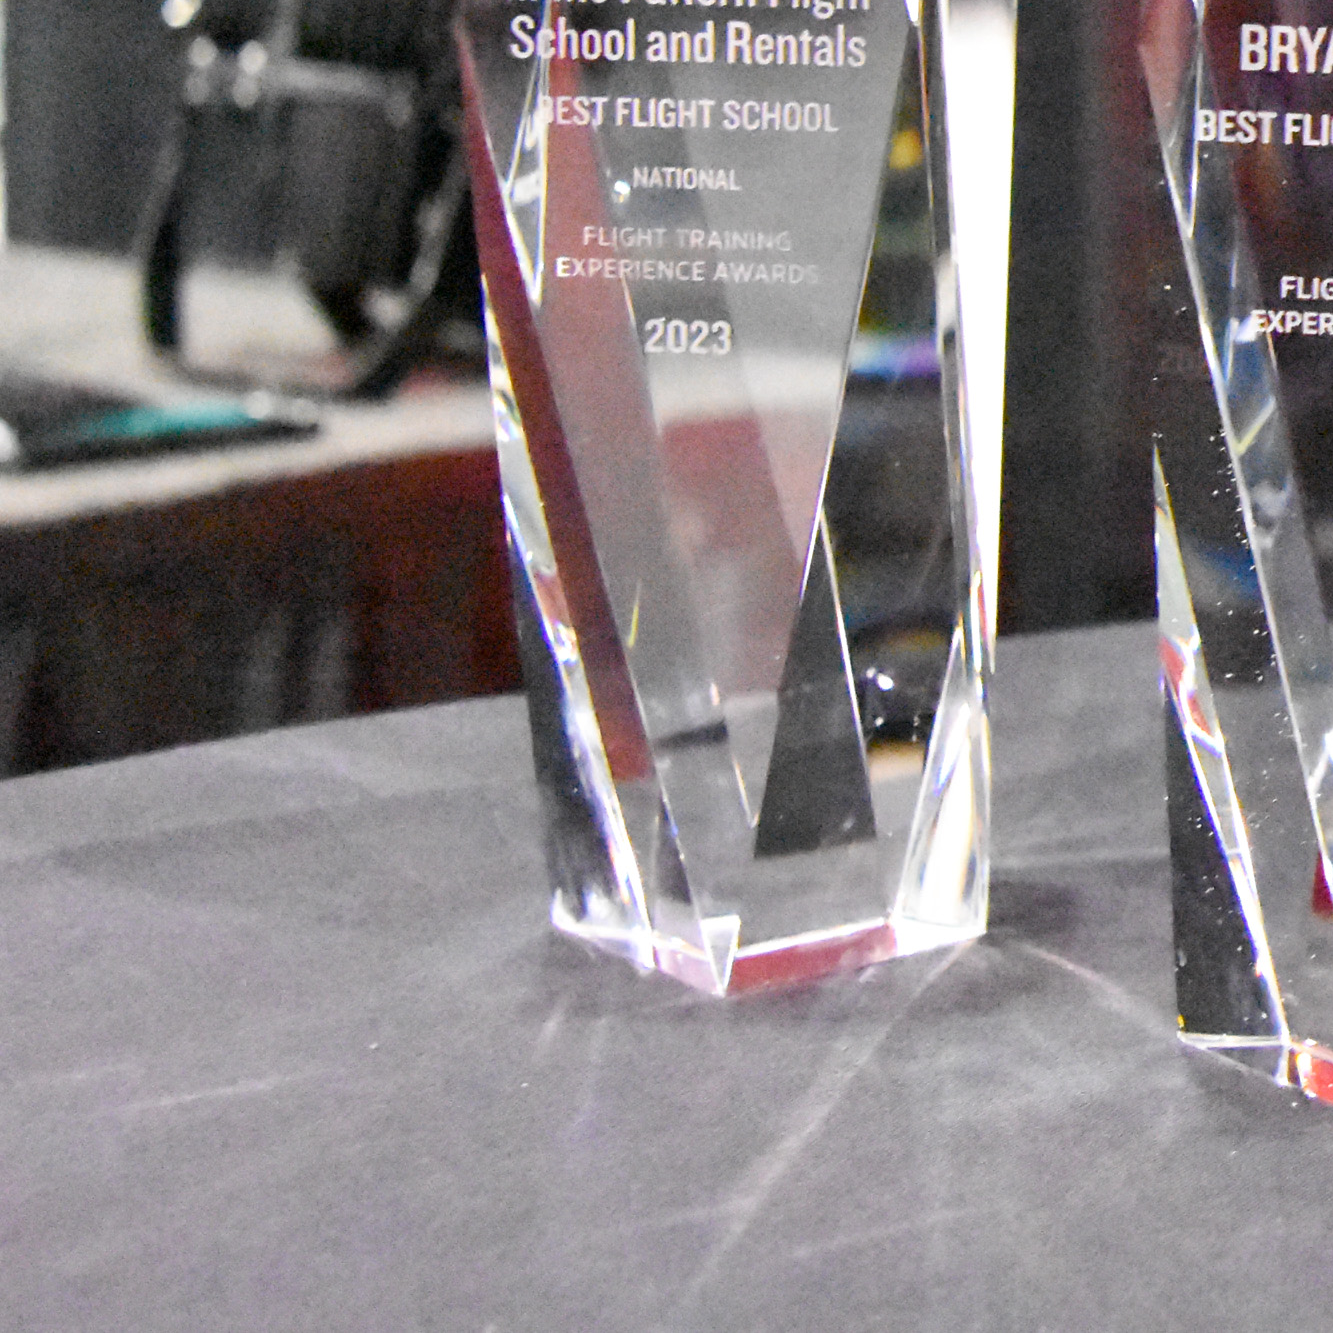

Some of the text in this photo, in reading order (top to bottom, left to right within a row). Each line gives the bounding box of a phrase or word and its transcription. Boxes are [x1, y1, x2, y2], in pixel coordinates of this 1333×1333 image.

[509, 15, 867, 67] School and Rentals
[540, 96, 839, 132] BEST FLIGHT SCHOOL
[1197, 109, 1277, 144] BEST
[632, 167, 742, 191] NATIONAL
[583, 226, 792, 251] FLIGHT TRAINING
[556, 257, 705, 282] EXPERIENCE
[644, 317, 733, 355] 2023
